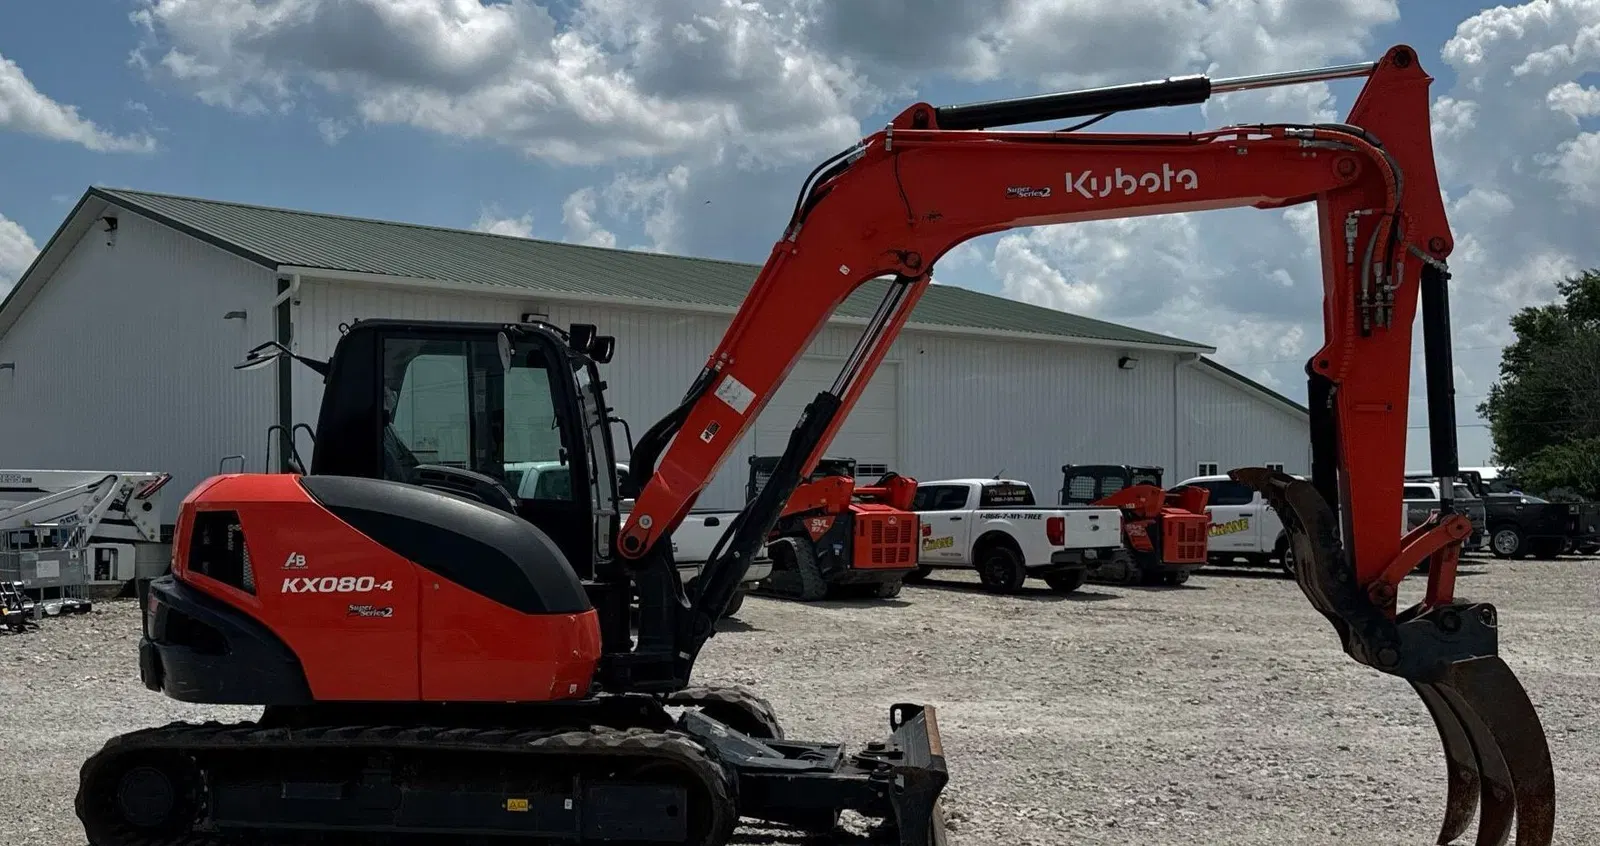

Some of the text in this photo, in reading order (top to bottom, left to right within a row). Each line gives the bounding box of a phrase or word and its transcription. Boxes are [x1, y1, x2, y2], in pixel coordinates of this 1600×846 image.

[1065, 163, 1198, 199] Kubota
[1007, 186, 1031, 194] Super
[811, 518, 829, 528] SVL
[281, 576, 393, 593] KX080-4
[348, 604, 372, 613] Super
